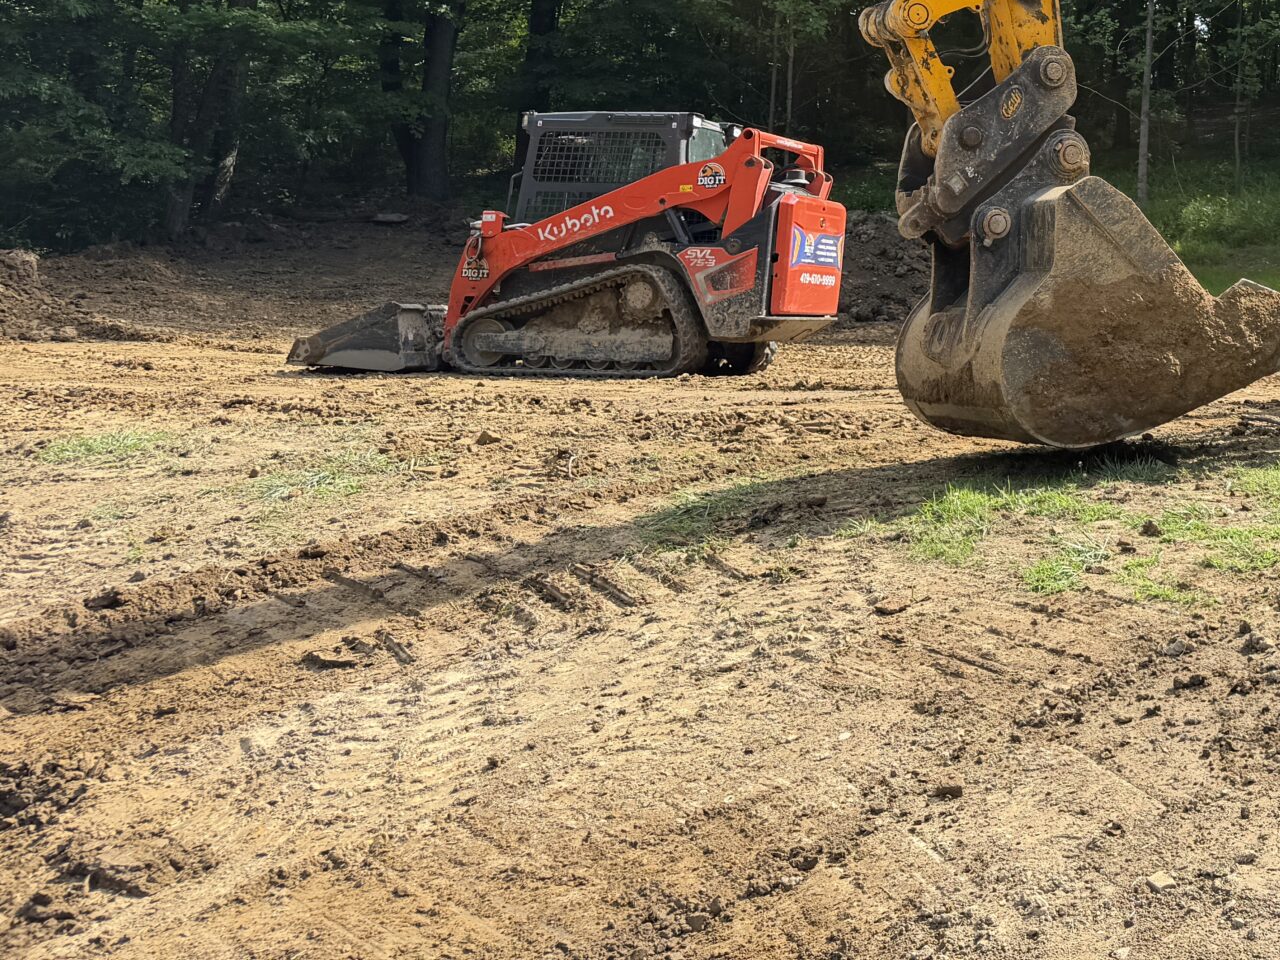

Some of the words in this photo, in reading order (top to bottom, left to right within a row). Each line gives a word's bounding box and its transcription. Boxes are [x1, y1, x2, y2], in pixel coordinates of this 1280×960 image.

[697, 176, 714, 186] DIG
[715, 176, 726, 185] IT
[537, 205, 615, 241] Kubota
[685, 249, 715, 259] SVL
[462, 269, 478, 278] DIG
[479, 269, 490, 278] IT
